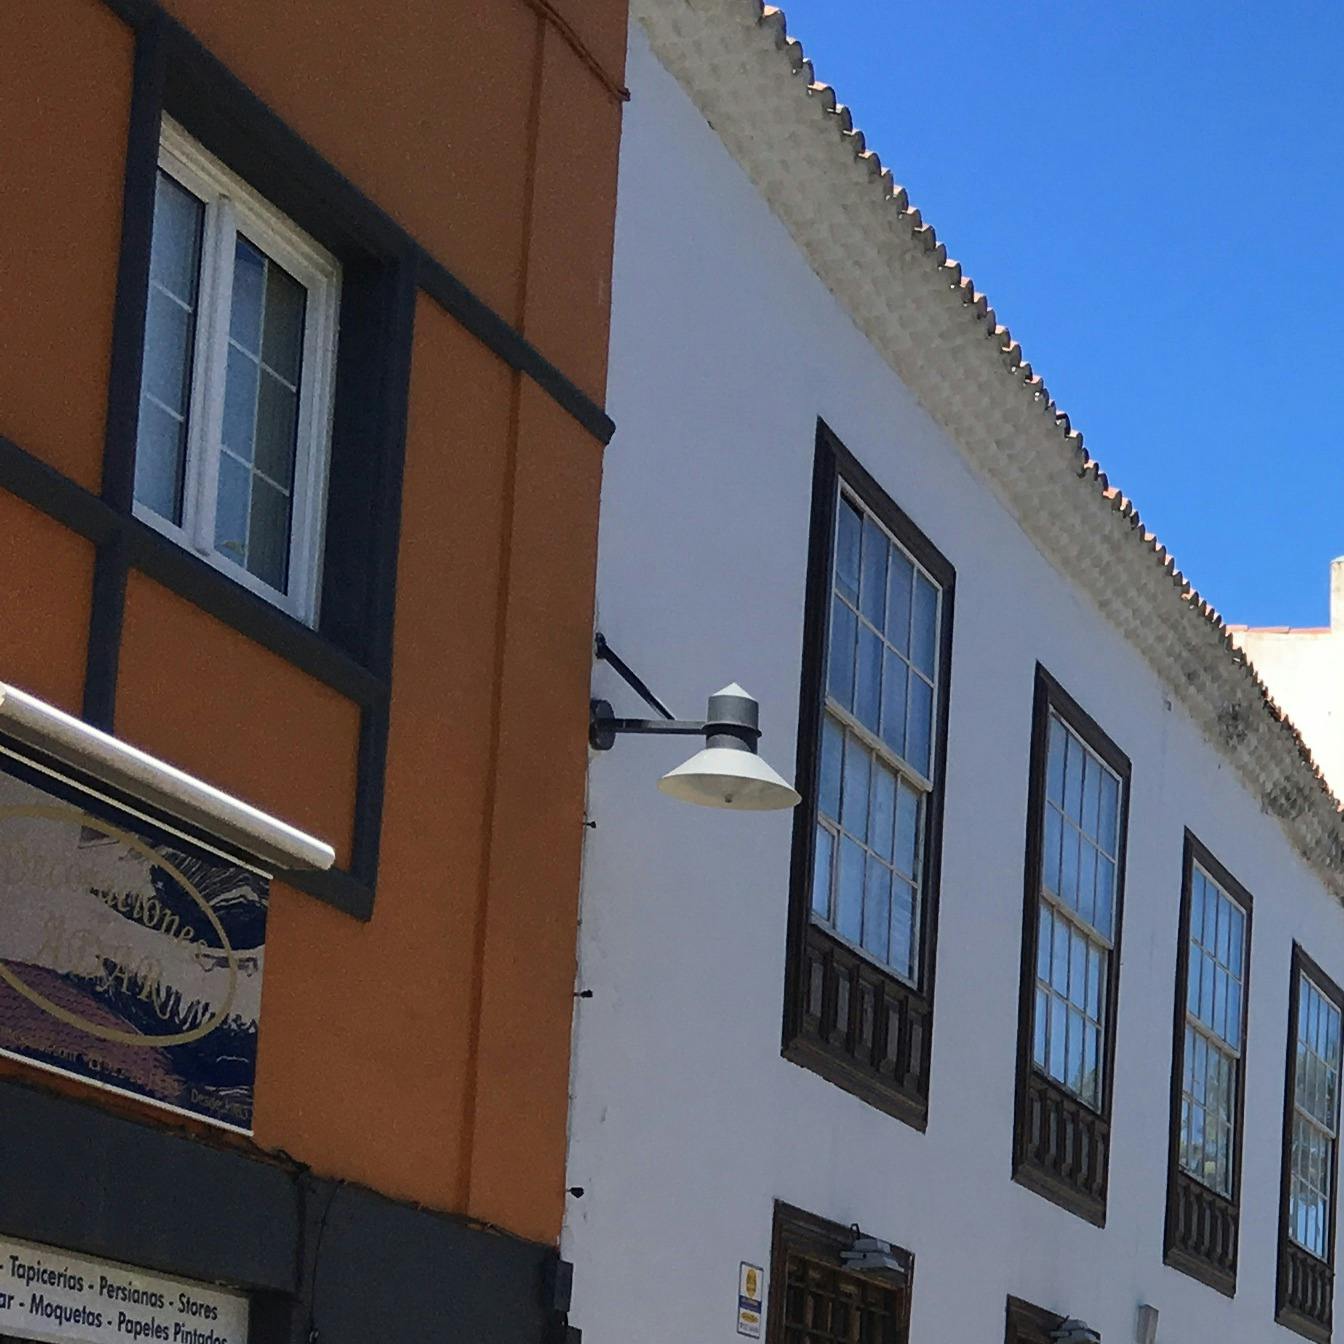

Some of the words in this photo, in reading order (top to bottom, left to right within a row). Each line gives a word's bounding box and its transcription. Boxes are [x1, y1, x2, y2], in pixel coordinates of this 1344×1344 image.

[9, 1254, 84, 1293] Tapicerías
[99, 1275, 164, 1309] Persianas
[178, 1292, 218, 1321] Stores
[29, 1292, 103, 1328] Moquetas
[118, 1311, 169, 1341] Papeles
